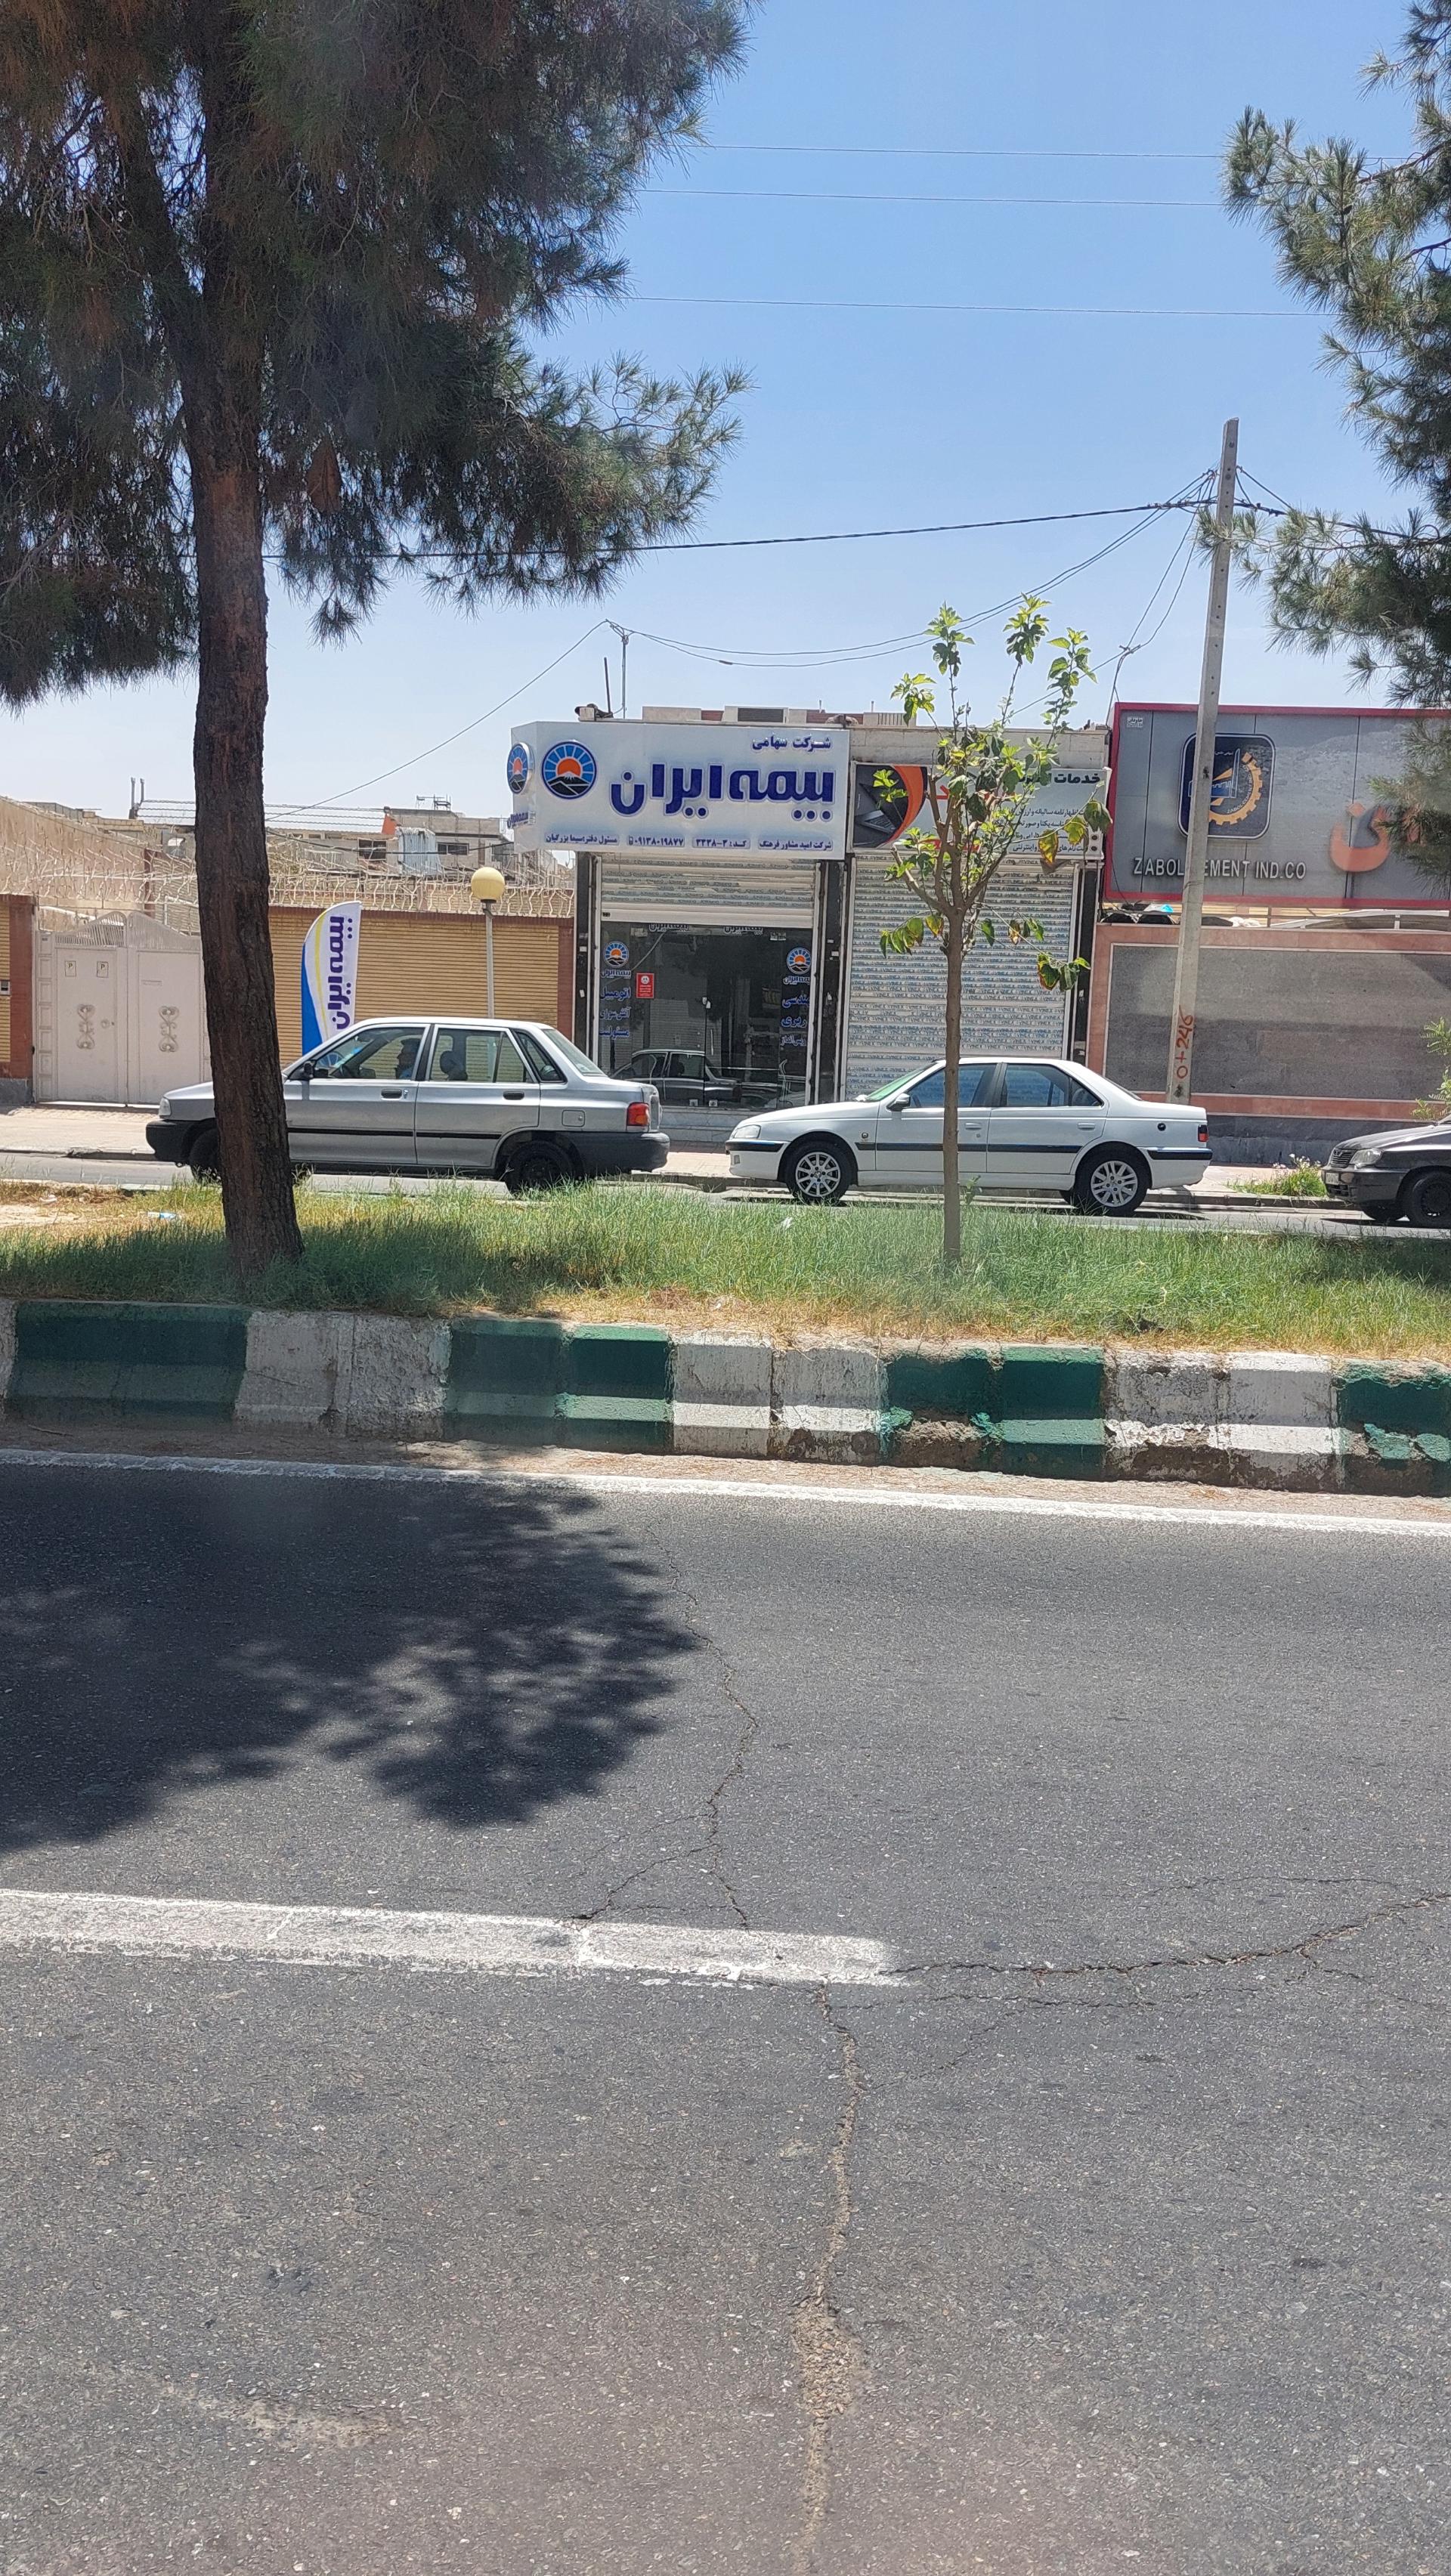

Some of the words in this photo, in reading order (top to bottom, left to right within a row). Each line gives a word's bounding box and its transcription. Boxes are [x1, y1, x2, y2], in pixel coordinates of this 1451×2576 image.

[752, 734, 787, 750] سهامی
[792, 736, 831, 753] شرکت
[1053, 772, 1101, 784] خدمات
[610, 763, 723, 816] ایران
[728, 770, 835, 821] بیمه
[599, 835, 618, 845] مسئول
[759, 839, 780, 849] فرهنگ
[781, 840, 799, 850] مشاور
[800, 840, 812, 850] امید
[813, 840, 832, 851] شرکت
[1134, 857, 1185, 876] ZABOL
[1205, 859, 1251, 878] EMENT
[329, 916, 353, 973] بیمه
[599, 985, 632, 1002] اتومبیل
[327, 976, 351, 1030] ایران
[598, 1025, 630, 1040] مسئولیت
